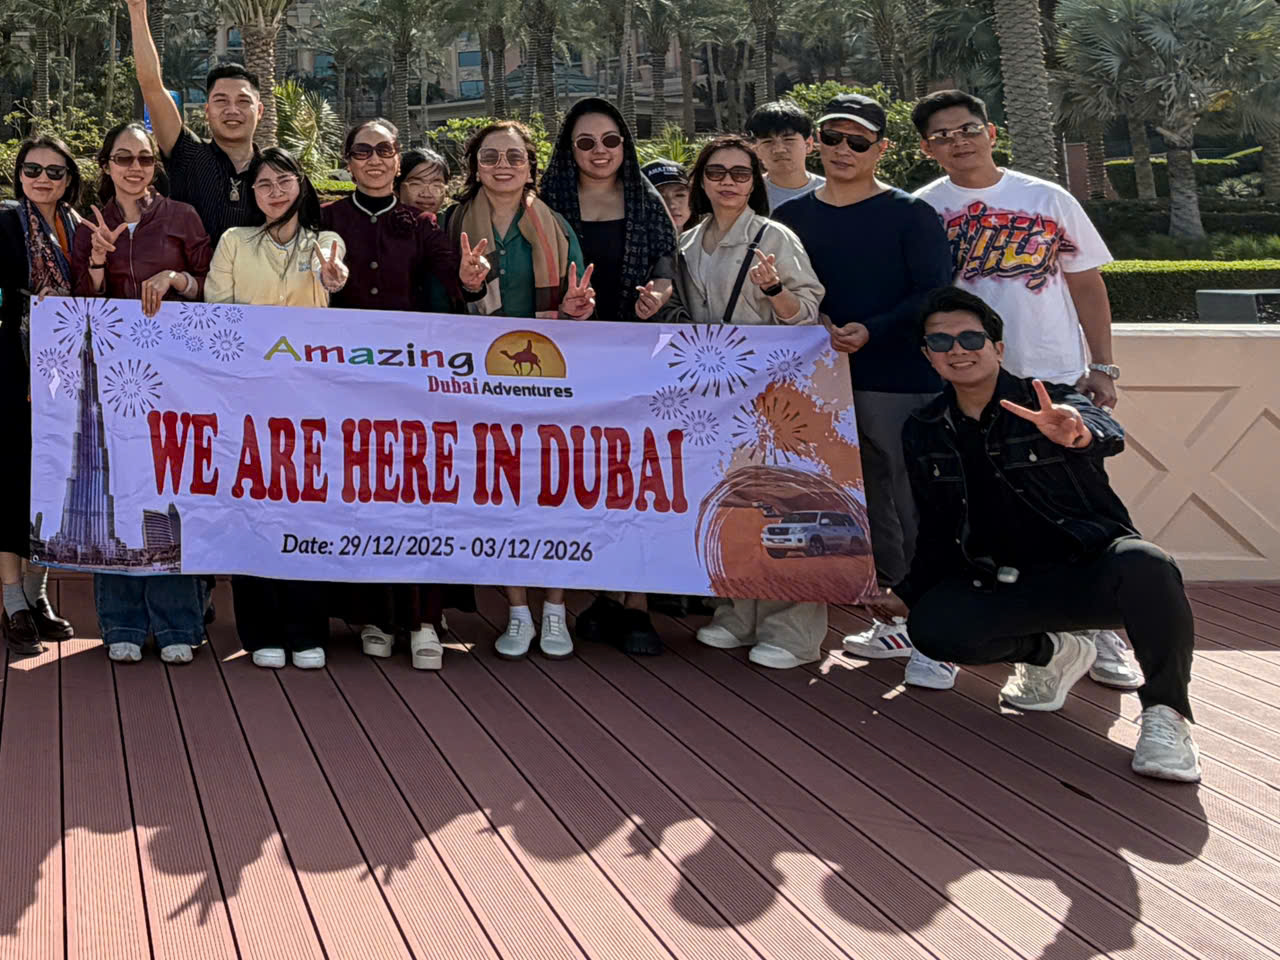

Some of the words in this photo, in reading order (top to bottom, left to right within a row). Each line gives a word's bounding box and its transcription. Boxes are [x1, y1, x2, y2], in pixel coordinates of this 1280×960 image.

[263, 335, 474, 376] Amazing
[426, 375, 480, 395] Dubai
[481, 381, 574, 398] Adventures
[147, 410, 219, 496] WE
[231, 413, 329, 503] ARE
[341, 418, 460, 505] HERE
[472, 422, 523, 507] IN
[537, 424, 688, 513] DUBAI
[281, 533, 334, 555] Date:
[338, 534, 455, 557] 29/12/2025
[471, 536, 593, 562] 03/12/2026
